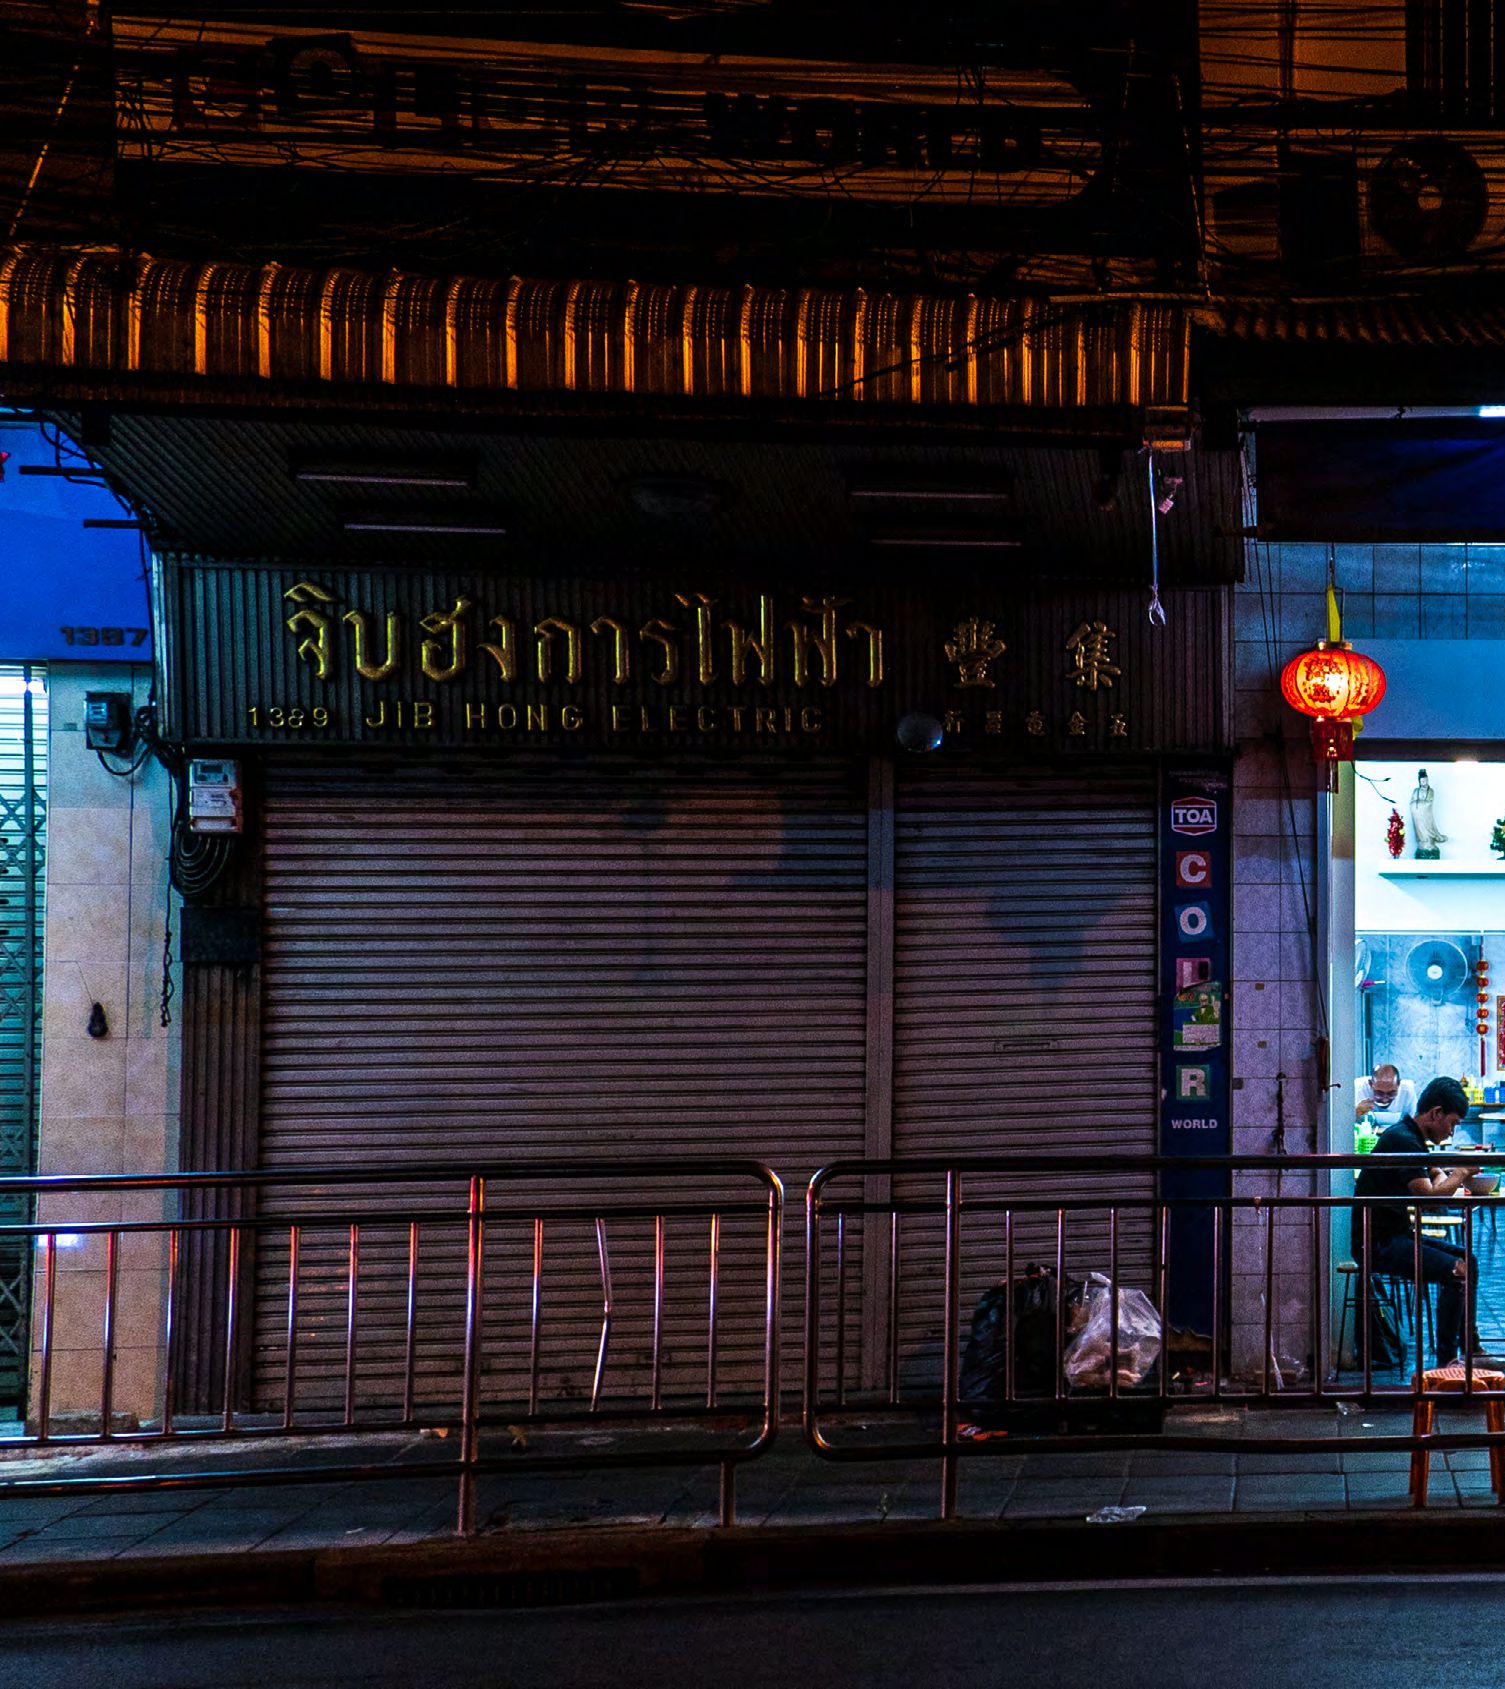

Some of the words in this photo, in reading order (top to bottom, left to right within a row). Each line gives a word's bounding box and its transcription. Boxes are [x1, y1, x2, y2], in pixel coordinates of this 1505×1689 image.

[60, 626, 149, 647] 1387
[247, 706, 329, 729] 1389
[366, 701, 433, 729] JIB
[465, 703, 584, 732] HONG
[611, 704, 823, 735] ELECTRIC
[1174, 808, 1213, 824] TOA
[1171, 1118, 1218, 1130] WORLD
